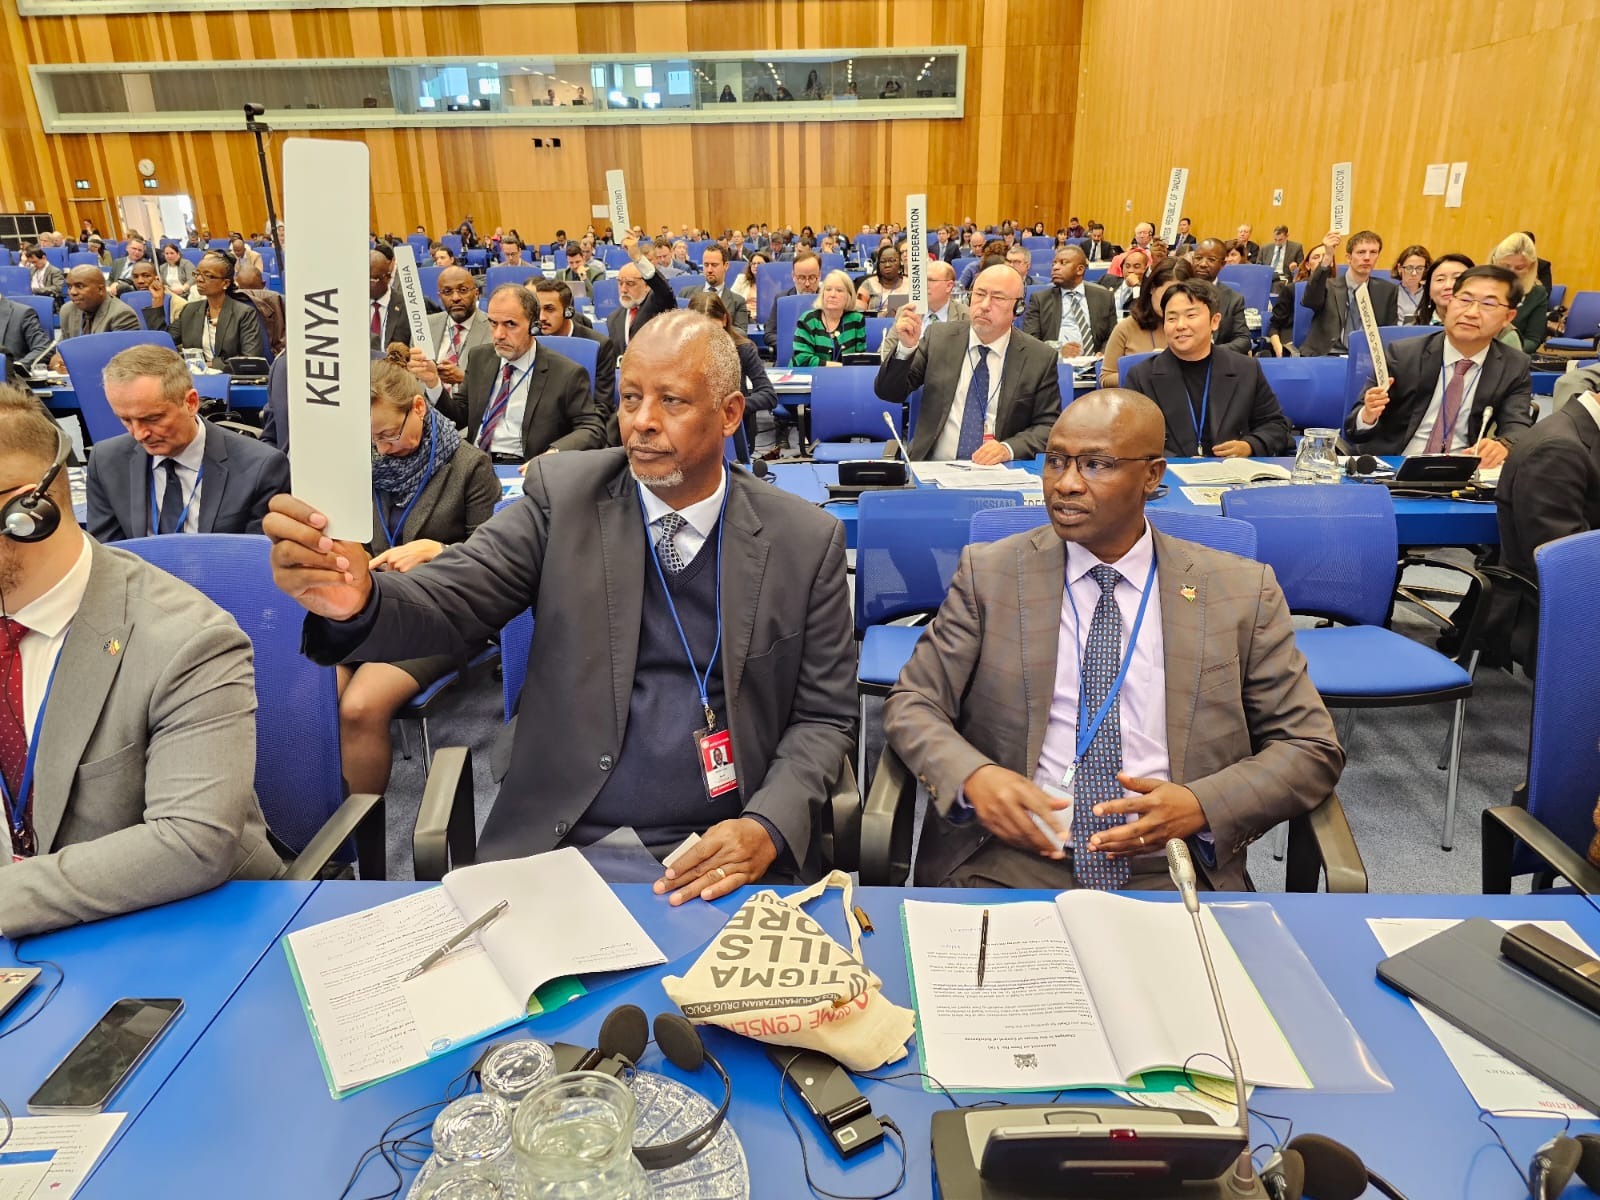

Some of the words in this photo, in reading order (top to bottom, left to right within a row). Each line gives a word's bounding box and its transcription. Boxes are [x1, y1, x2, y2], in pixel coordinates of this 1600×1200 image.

[1170, 169, 1182, 192] TANZANIA
[1335, 170, 1345, 202] KINGDOM
[614, 189, 625, 224] URUGUAY
[1169, 193, 1178, 201] OF
[1164, 201, 1176, 226] REPUBLIC
[1334, 205, 1344, 230] UNITED
[910, 208, 920, 262] FEDERATION
[402, 265, 418, 305] ARABIA
[911, 264, 921, 301] RUSSIAN
[411, 310, 426, 342] SAUDI
[1360, 296, 1371, 330] KOREA
[304, 288, 340, 407] KENYA
[1367, 330, 1376, 343] OF
[1371, 342, 1385, 386] REPUBLIC
[724, 906, 826, 937] ORE
[713, 1001, 740, 1012] DRUG
[741, 996, 813, 1009] HUMANITARIAN
